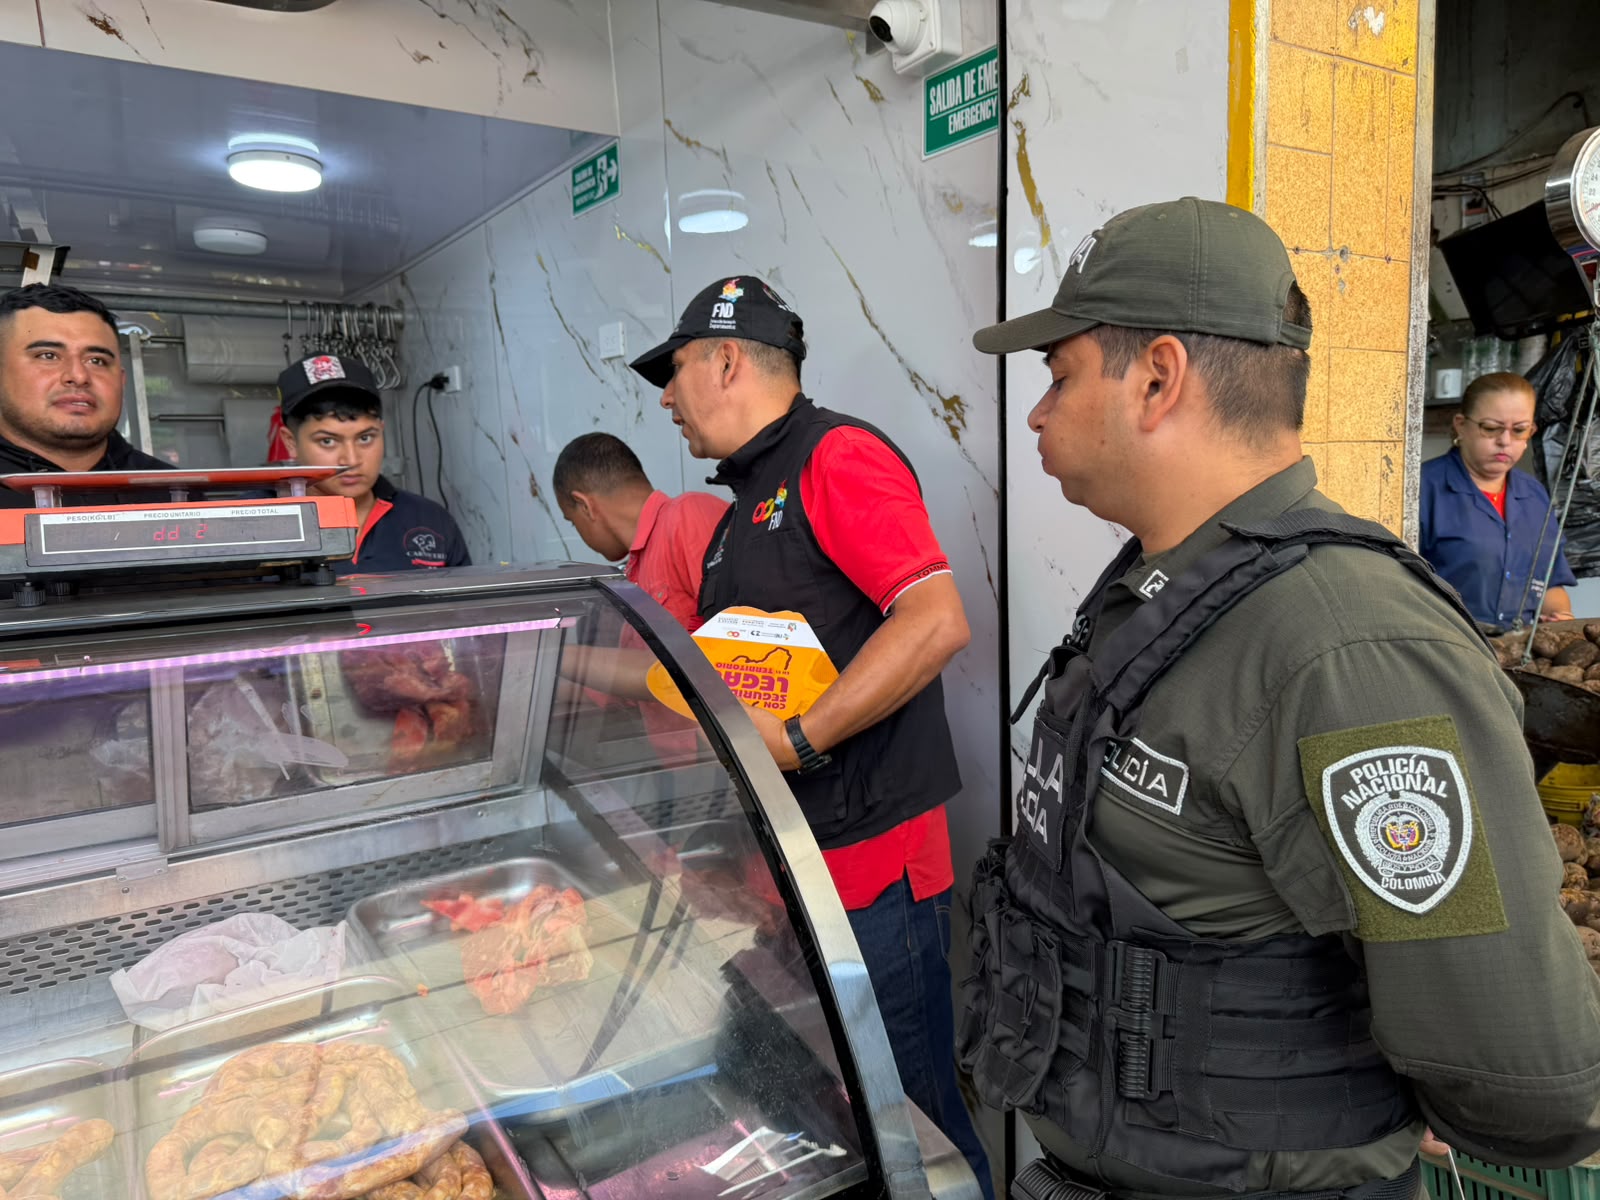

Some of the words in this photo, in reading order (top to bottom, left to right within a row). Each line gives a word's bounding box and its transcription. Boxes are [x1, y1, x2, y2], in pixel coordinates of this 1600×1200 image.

[929, 75, 963, 116] SALIDA
[963, 68, 977, 102] DE
[977, 58, 998, 96] EME
[948, 95, 998, 135] EMERGENCY
[711, 302, 734, 318] FND
[715, 662, 773, 674] TERRITORIO
[716, 671, 789, 693] LEGA
[764, 701, 786, 710] CON
[1349, 754, 1430, 785] POLICÍA
[1340, 774, 1448, 810] NACIONAL
[1381, 872, 1446, 890] COLOMBIA
